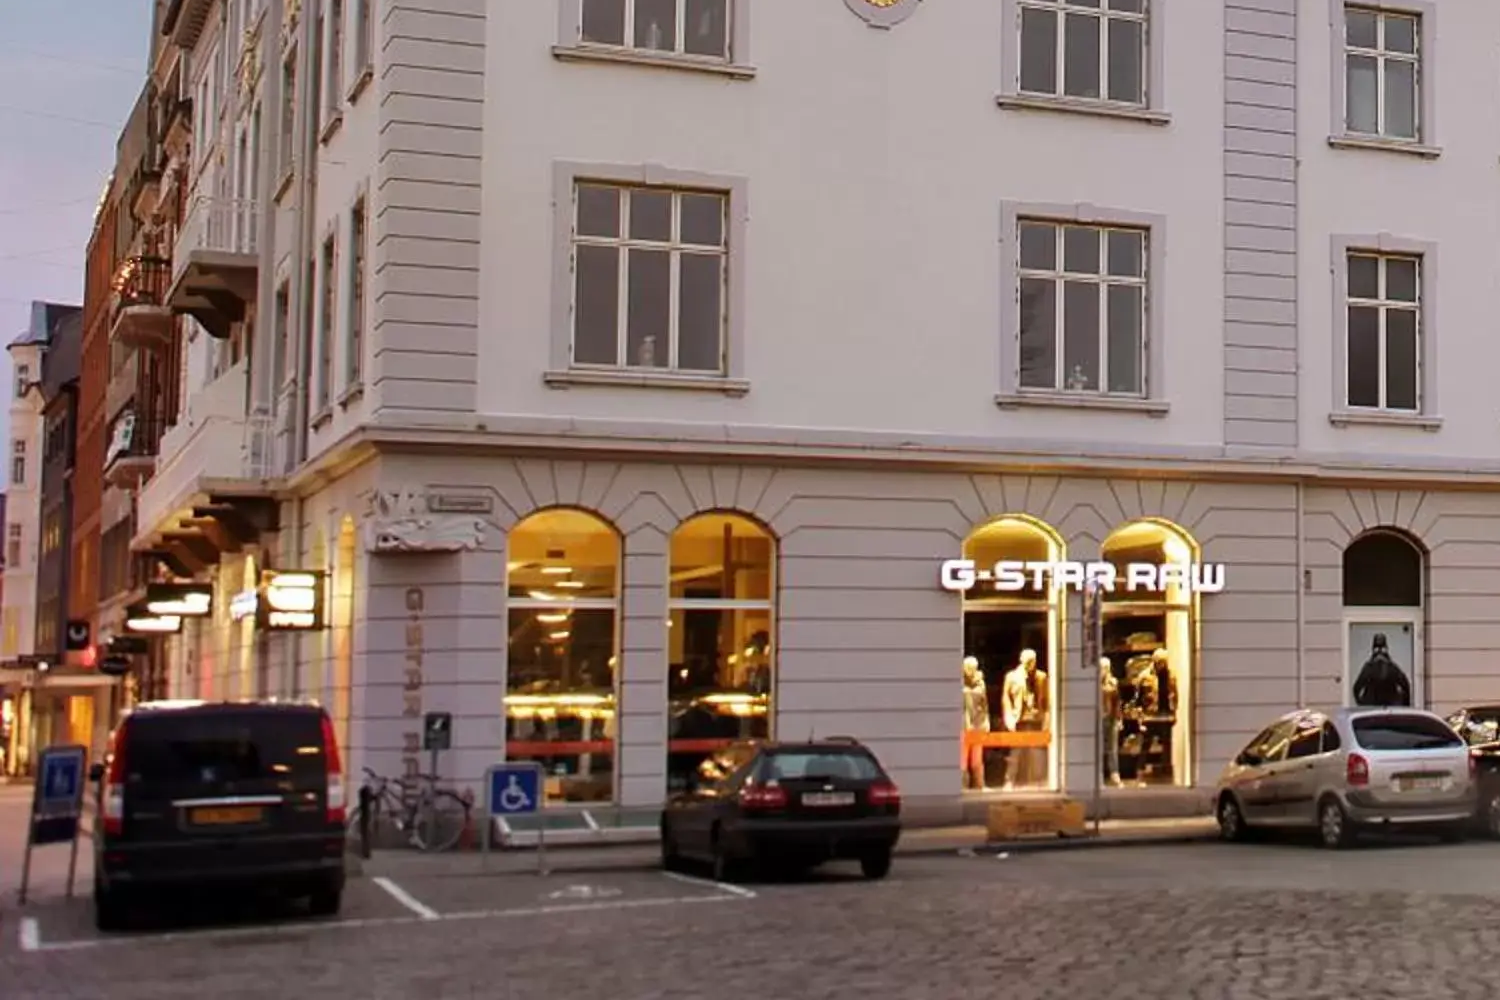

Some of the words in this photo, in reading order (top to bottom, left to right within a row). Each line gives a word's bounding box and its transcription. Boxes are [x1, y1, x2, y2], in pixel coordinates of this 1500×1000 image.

[941, 560, 1116, 592] G-STAR
[1127, 561, 1225, 593] RAW
[404, 587, 423, 718] G-STAR
